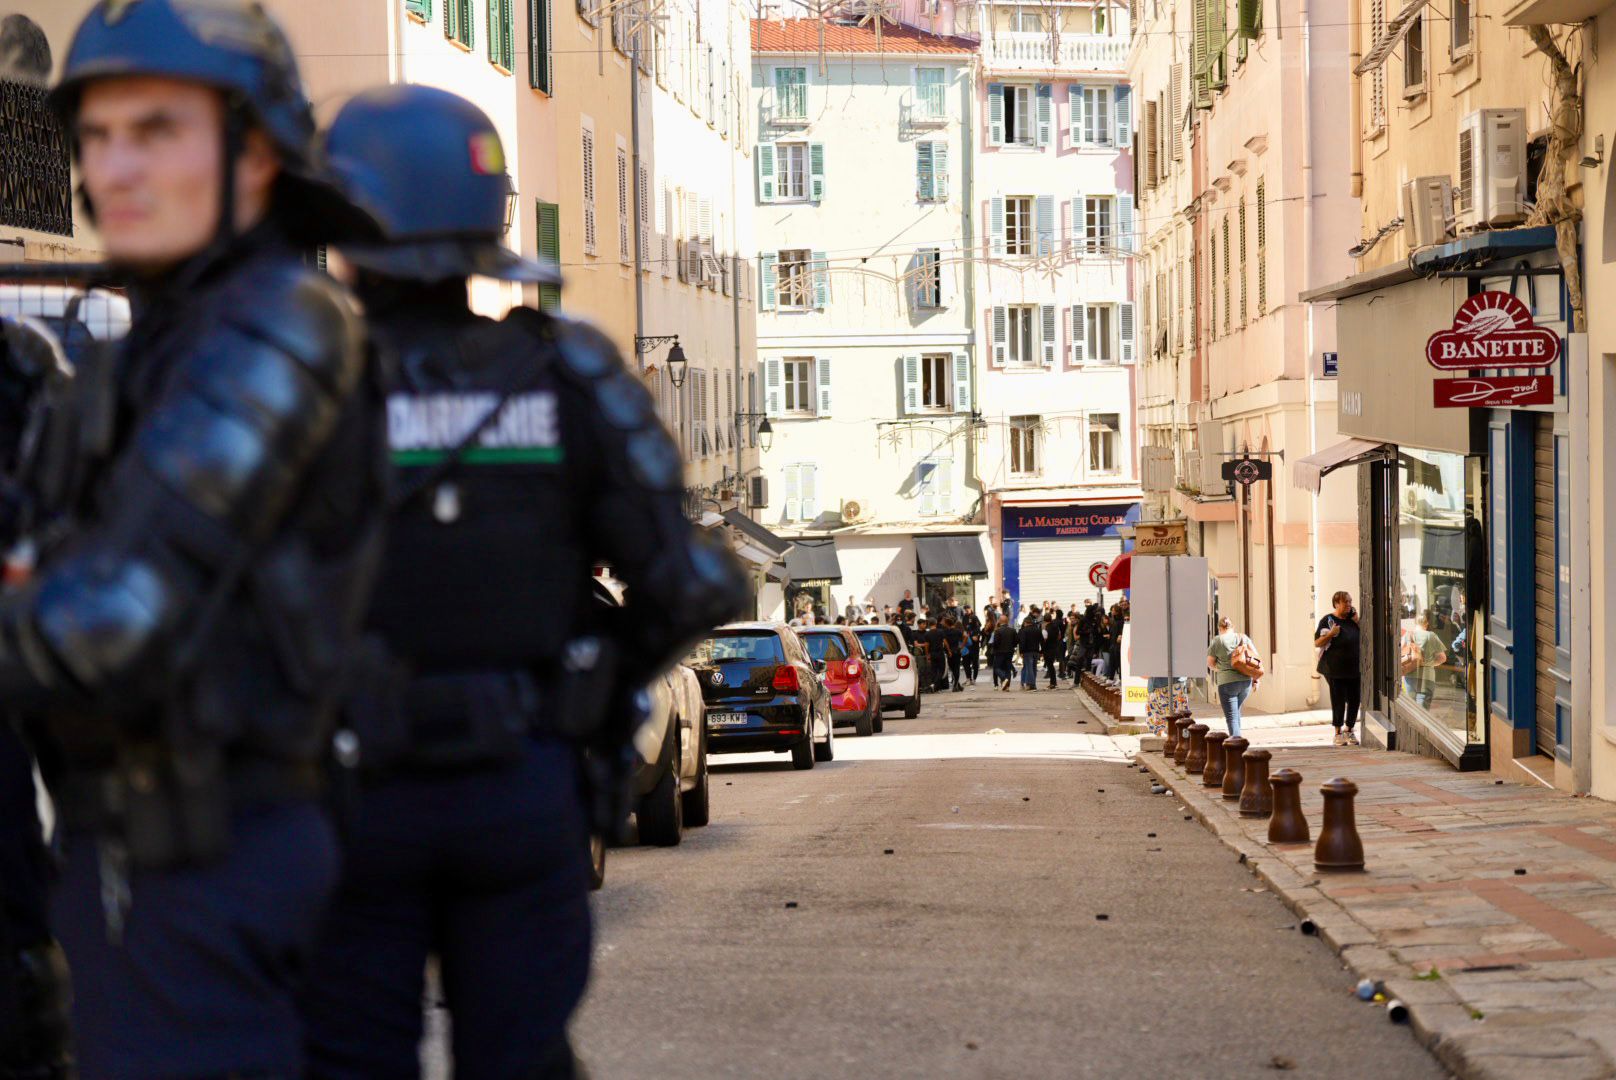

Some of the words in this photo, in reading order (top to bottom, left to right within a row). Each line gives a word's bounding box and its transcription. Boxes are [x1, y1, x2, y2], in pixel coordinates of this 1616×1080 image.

[1440, 338, 1546, 359] BANETTE
[1018, 516, 1033, 528] LA
[1034, 516, 1073, 528] MAISON
[1074, 517, 1089, 526] DU
[1090, 514, 1127, 525] CORAIL
[1056, 527, 1089, 535] FASHION
[1140, 536, 1182, 547] COIFFURE
